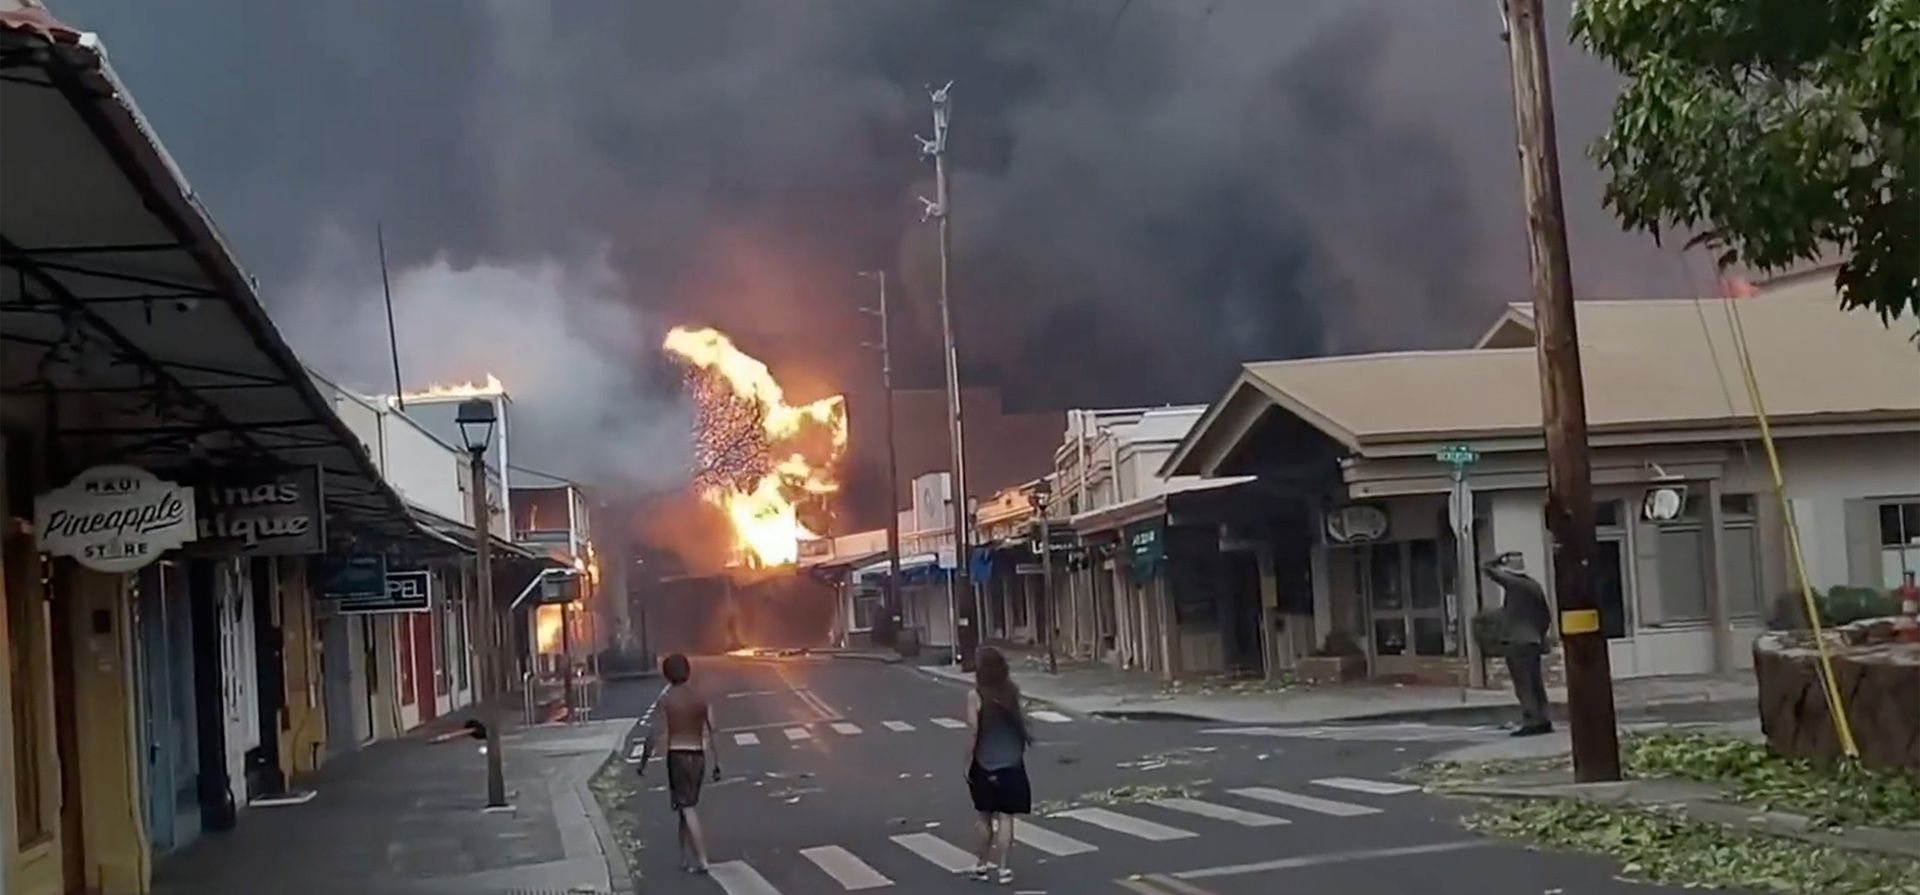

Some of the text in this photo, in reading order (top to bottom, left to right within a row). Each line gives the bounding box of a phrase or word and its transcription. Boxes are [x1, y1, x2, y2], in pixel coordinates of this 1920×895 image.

[85, 476, 141, 492] MAUI
[43, 492, 184, 540] Pineapple
[198, 513, 309, 547] tique
[386, 579, 425, 598] PEL
